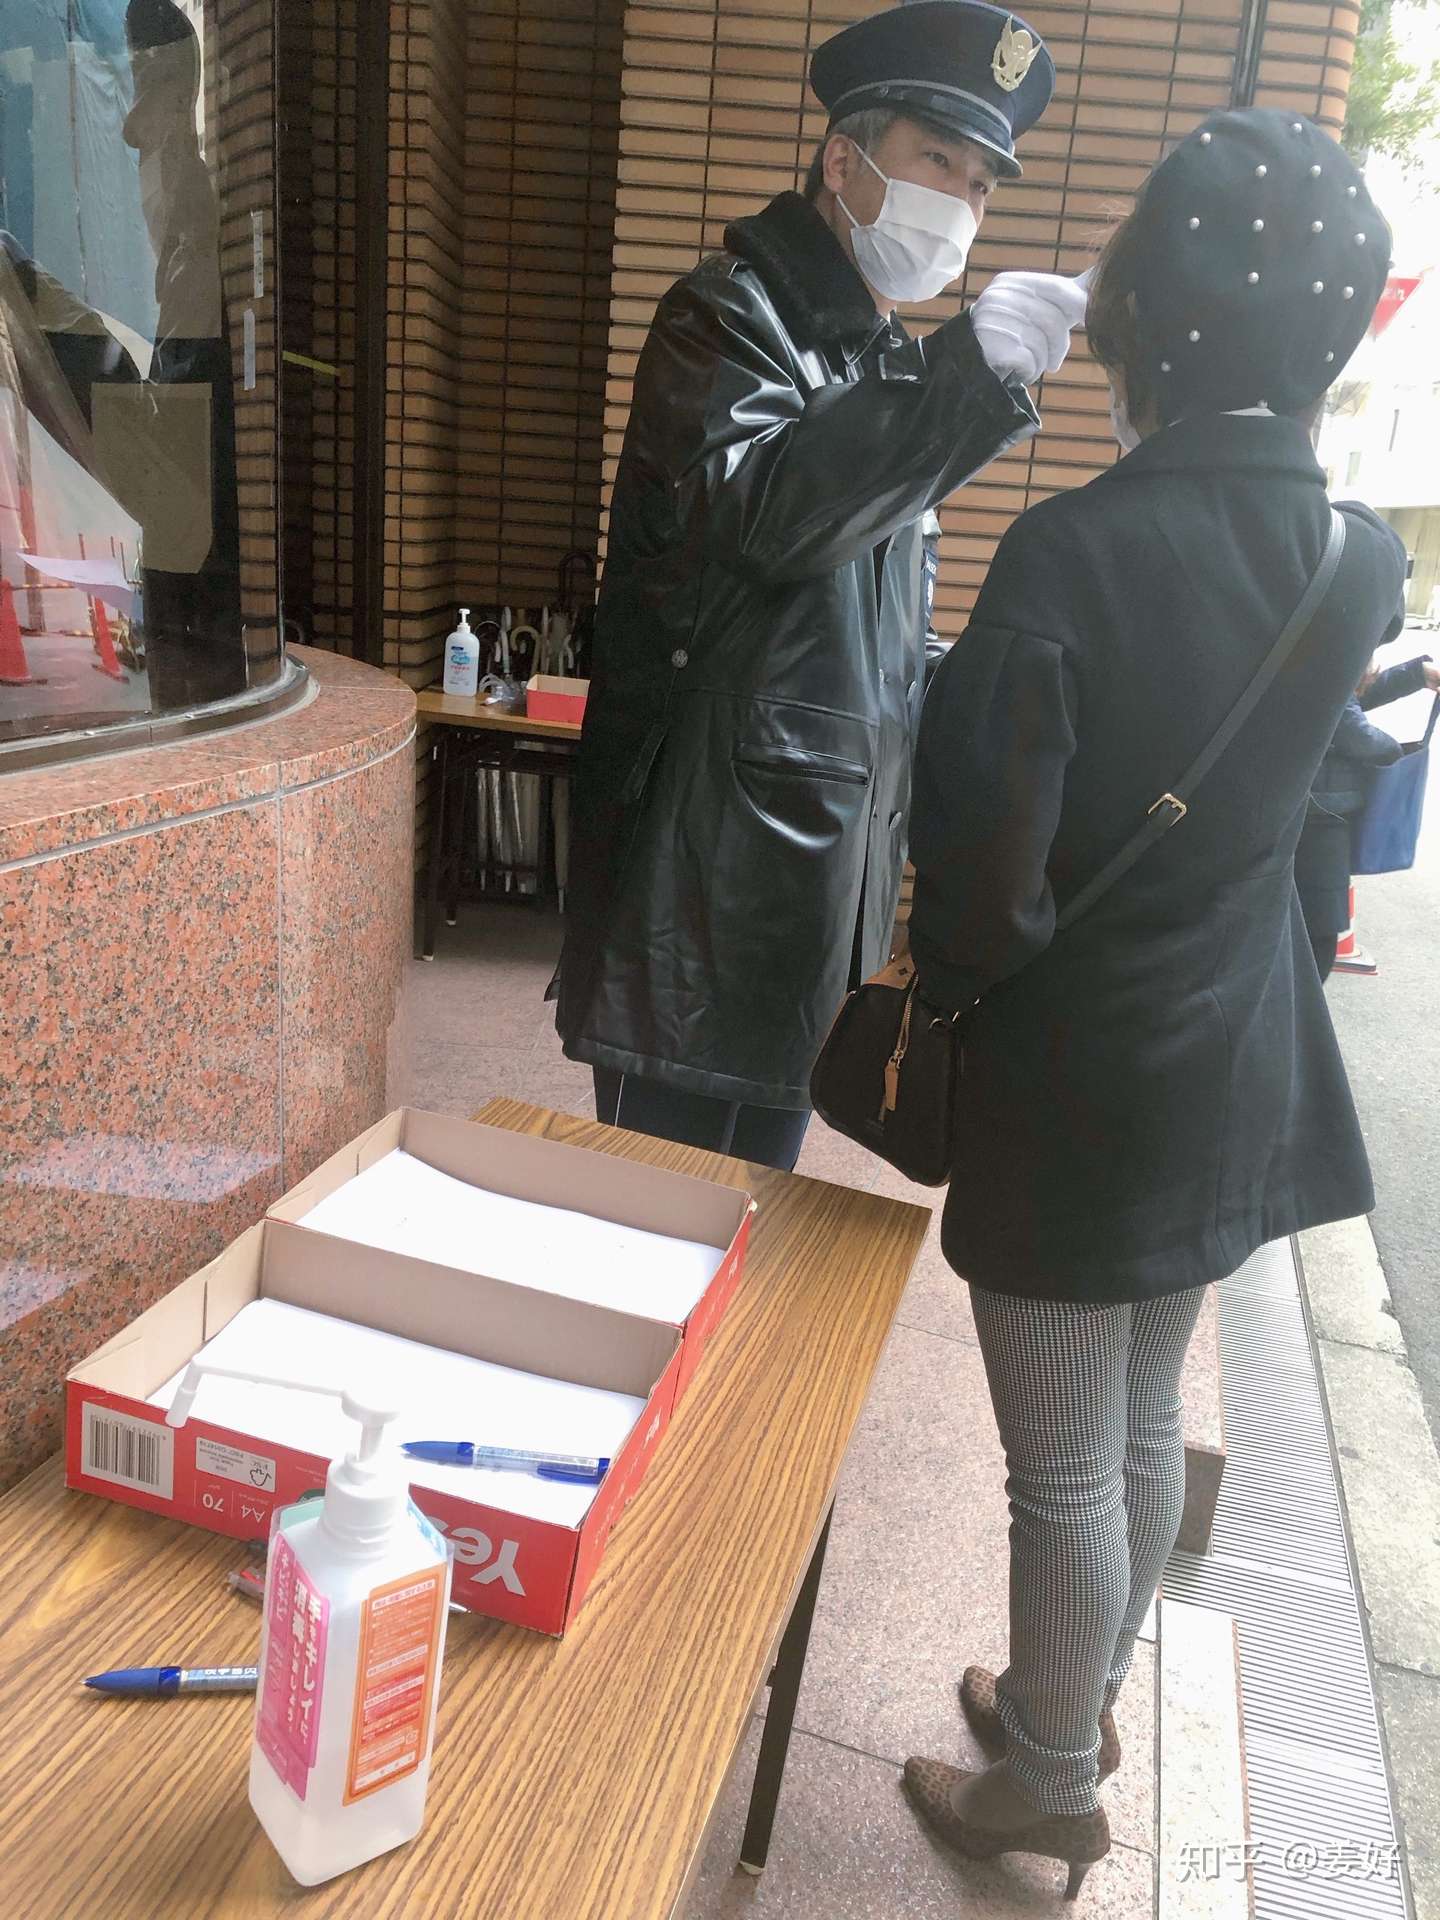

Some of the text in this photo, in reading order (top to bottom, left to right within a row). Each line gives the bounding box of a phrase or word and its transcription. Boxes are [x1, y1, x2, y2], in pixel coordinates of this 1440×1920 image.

[202, 1492, 225, 1513] 70
[240, 1504, 266, 1524] A4
[427, 1516, 527, 1597] Ye
